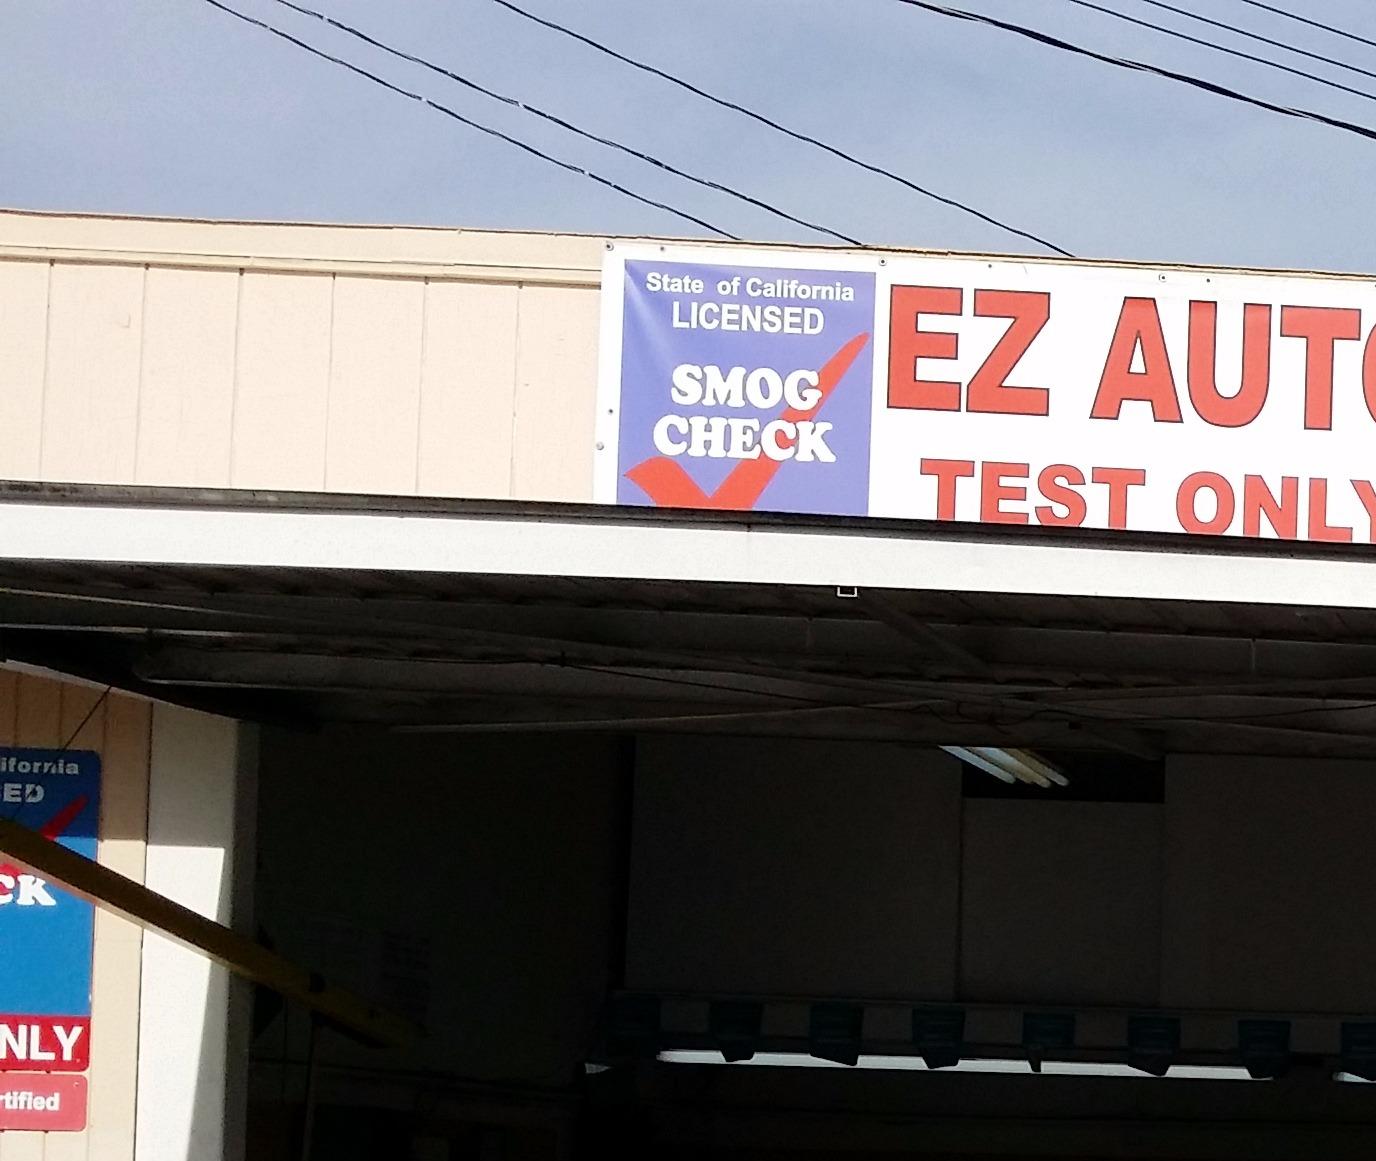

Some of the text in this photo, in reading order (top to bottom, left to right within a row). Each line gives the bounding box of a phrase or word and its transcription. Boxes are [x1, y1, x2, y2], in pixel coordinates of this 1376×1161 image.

[646, 272, 854, 302] State of California
[672, 301, 825, 336] LICENSED
[887, 284, 1051, 416] EZ
[671, 364, 823, 410] SMOG
[653, 414, 837, 463] CHECK
[920, 458, 1146, 530] TEST
